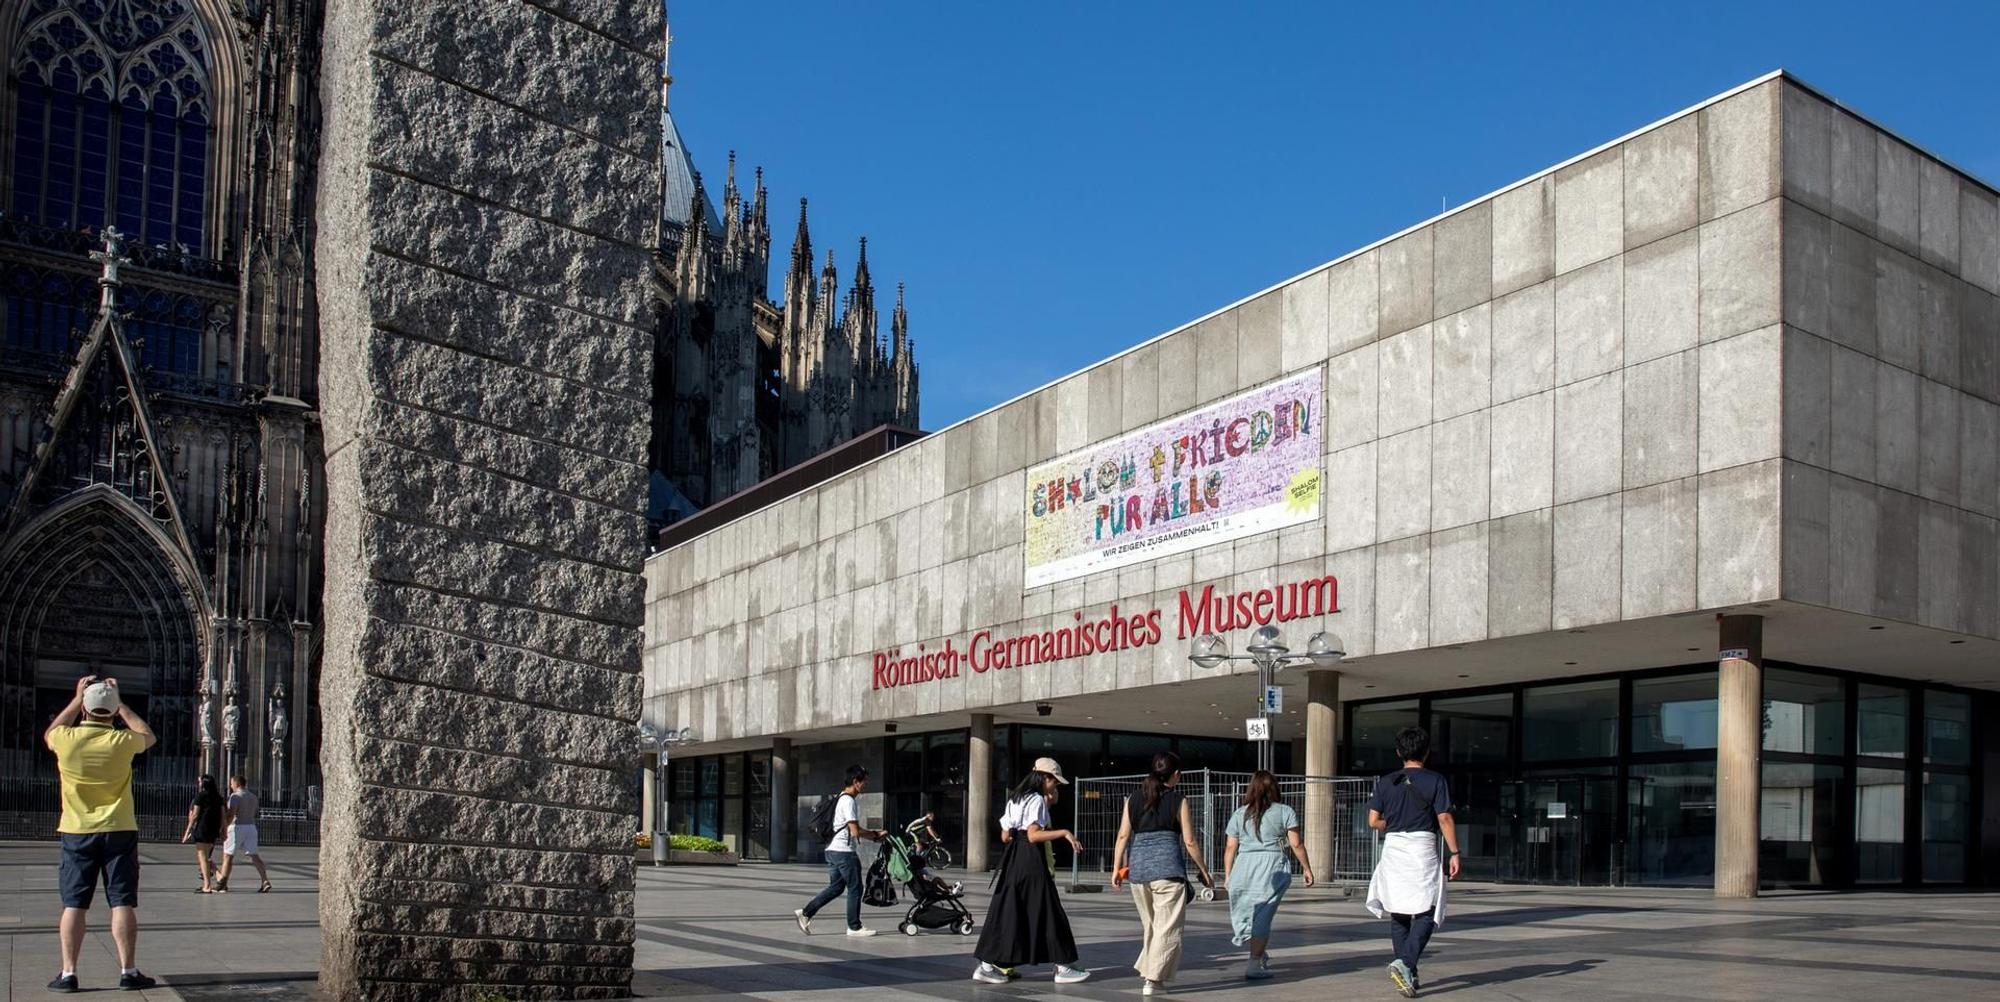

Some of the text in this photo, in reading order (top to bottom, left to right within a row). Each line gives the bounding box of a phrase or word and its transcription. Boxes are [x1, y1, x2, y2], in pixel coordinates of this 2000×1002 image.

[1173, 393, 1312, 478] FRIEDEN
[1096, 470, 1222, 541] FÜR ALLE
[1290, 476, 1319, 494] SHALOM
[1294, 484, 1317, 498] SELFIE
[1102, 521, 1220, 558] WIR ZEIGEN ZUSAMMENHALT!
[872, 574, 1341, 691] Römisch-Germanisches Museum
